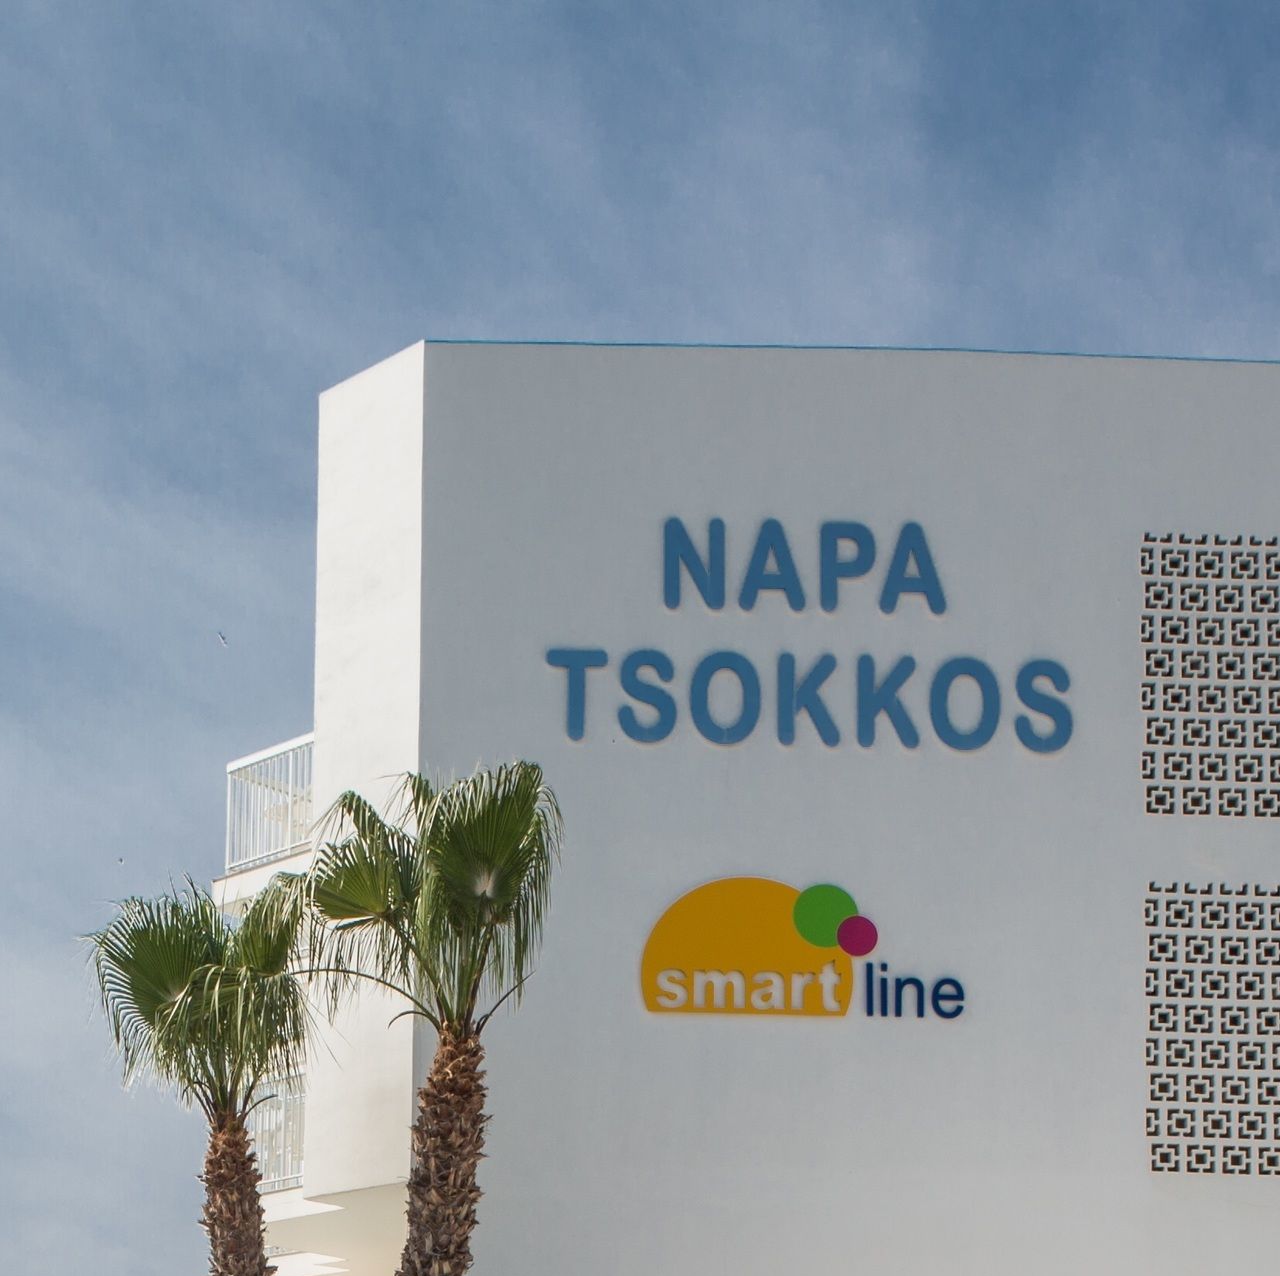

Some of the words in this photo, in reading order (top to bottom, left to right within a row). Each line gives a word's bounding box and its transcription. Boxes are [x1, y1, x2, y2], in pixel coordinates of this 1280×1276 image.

[663, 516, 947, 615] NAPA
[546, 648, 1073, 753] TSOKKOS
[655, 959, 842, 1012] smart
[866, 962, 965, 1019] line
